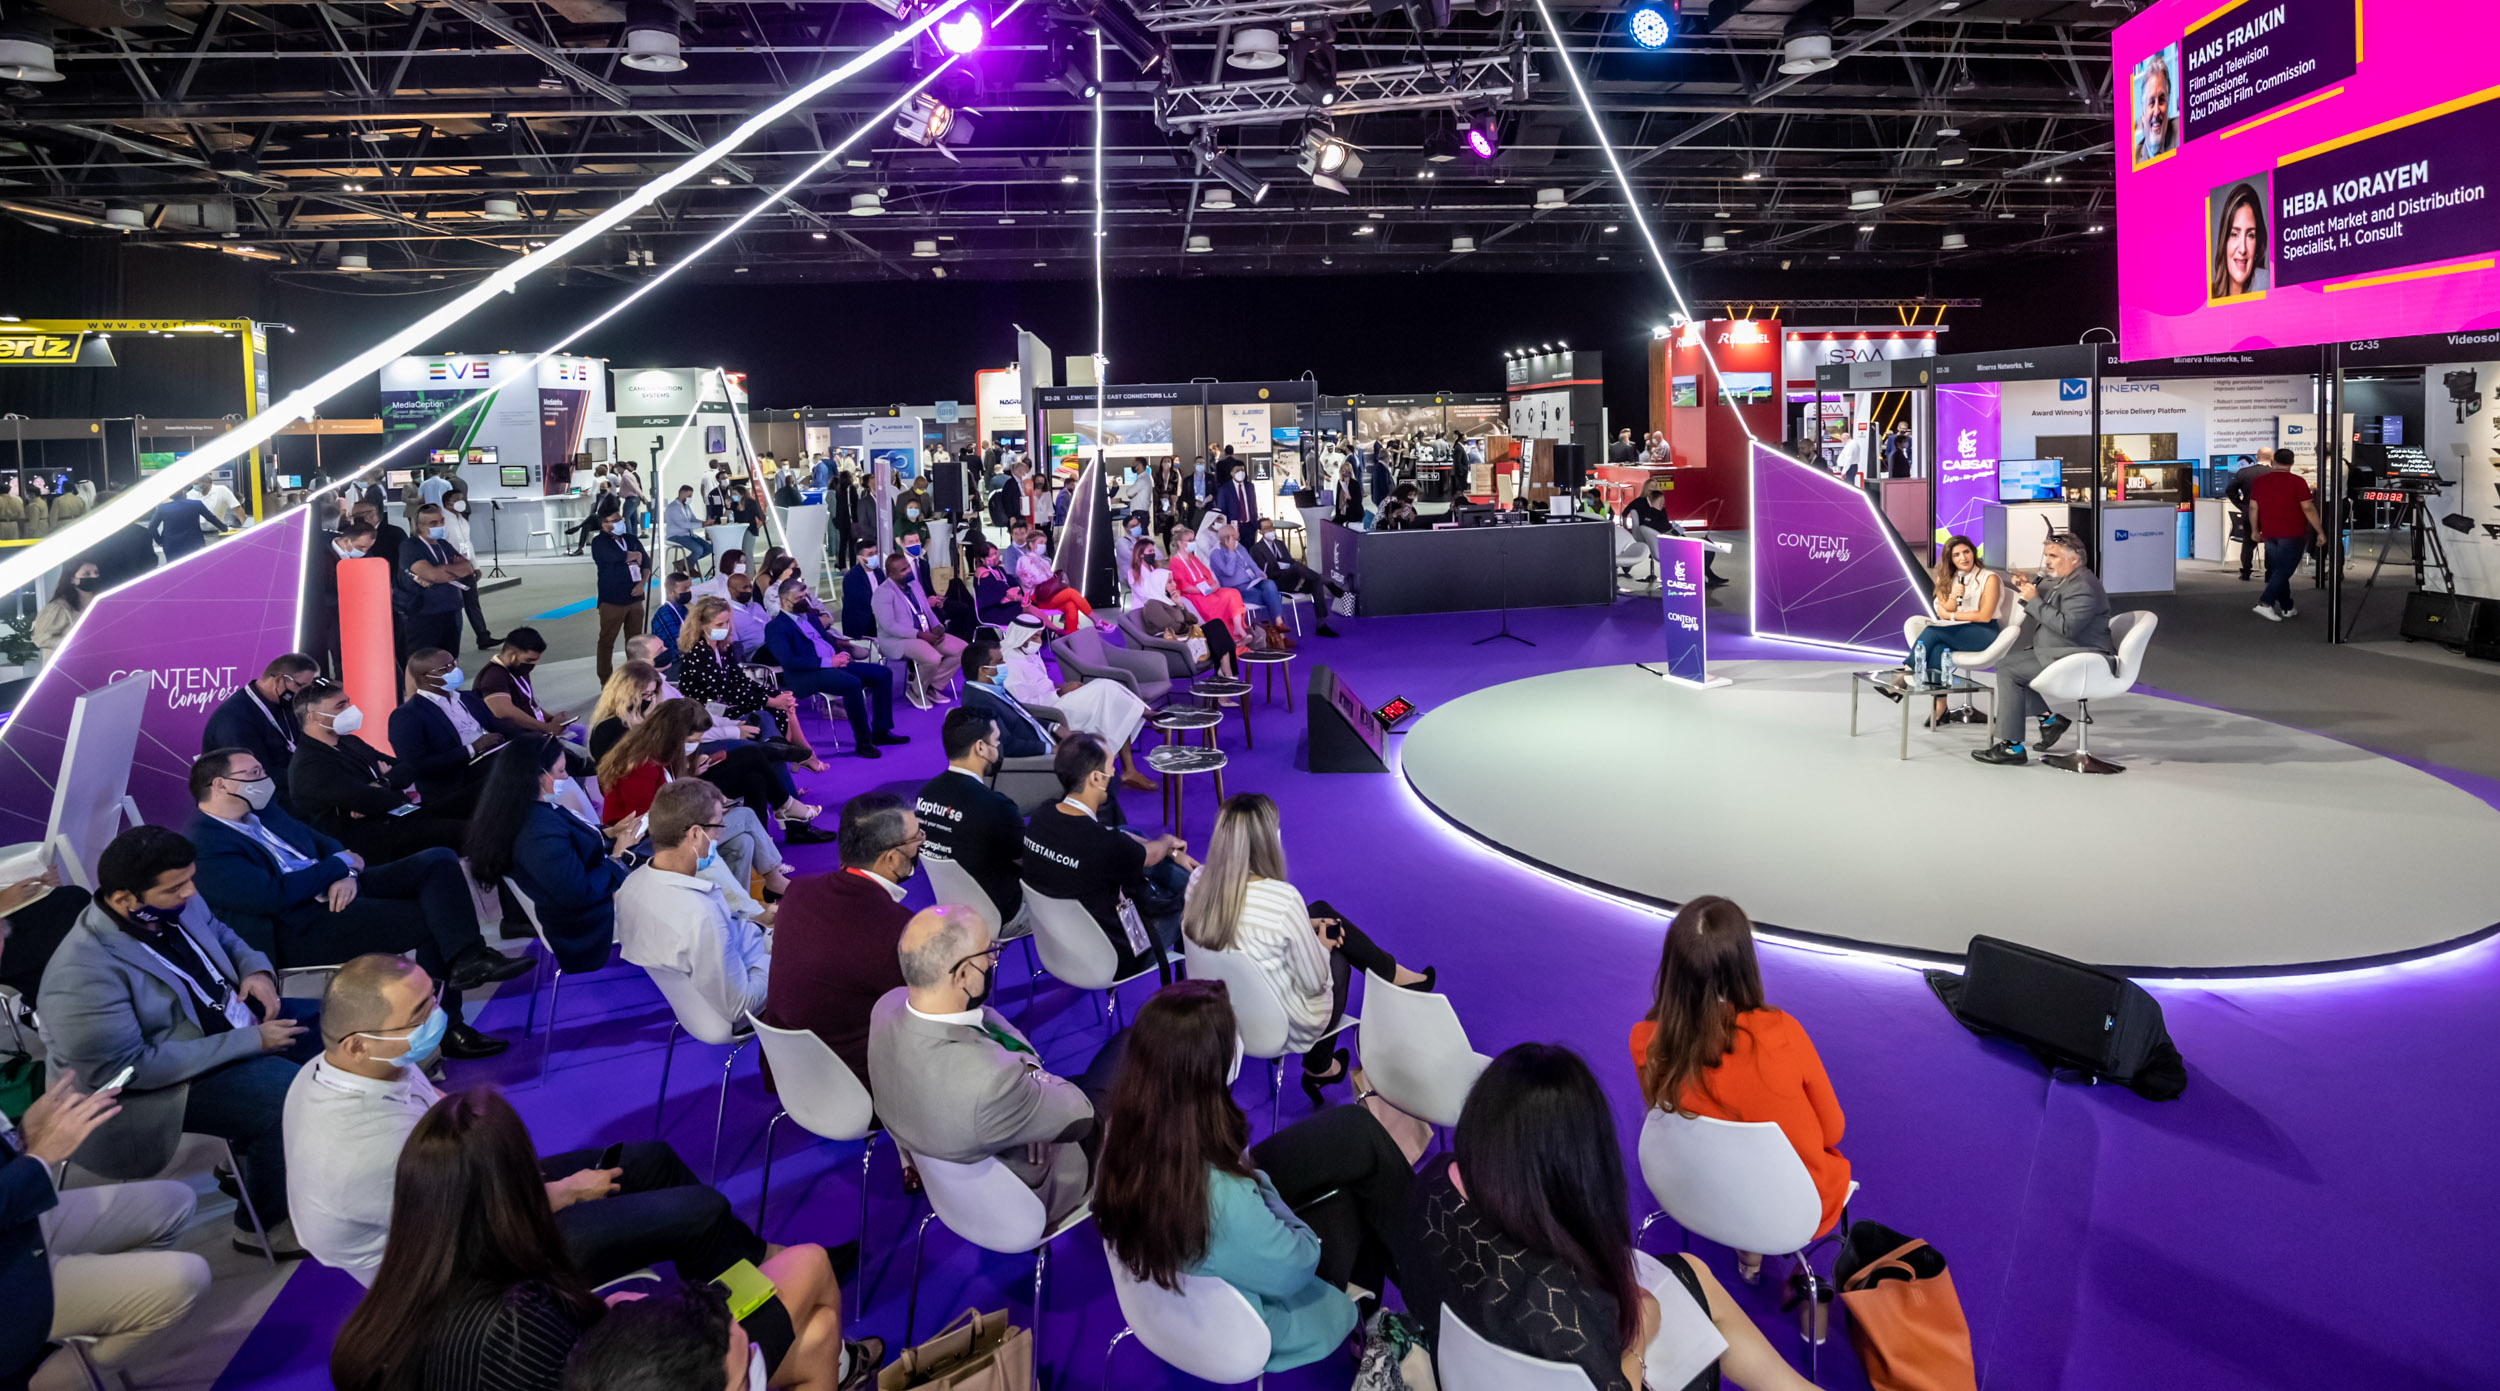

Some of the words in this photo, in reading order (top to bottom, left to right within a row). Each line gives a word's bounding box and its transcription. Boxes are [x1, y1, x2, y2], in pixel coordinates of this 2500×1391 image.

[2189, 37, 2223, 71] HANS
[2226, 3, 2285, 52] FRAIKIN
[2189, 76, 2206, 92] Film
[2208, 64, 2223, 83] and
[2225, 45, 2269, 74] Television
[2189, 72, 2249, 107] Commissioner,
[2190, 107, 2206, 123] Abu
[2208, 93, 2232, 115] Dhabi
[2234, 86, 2253, 103] Film
[2255, 58, 2316, 93] Commission
[2283, 188, 2328, 218] HEBA
[2333, 160, 2428, 206] KORAYEM
[2283, 221, 2325, 242] Content
[2328, 210, 2367, 233] Market
[2371, 203, 2395, 222] and
[2399, 185, 2485, 217] Distribution
[2283, 238, 2337, 261] Specialist,
[2340, 233, 2352, 248] H.
[2355, 221, 2403, 245] Consult
[2350, 340, 2380, 351] C2-35
[1998, 362, 2024, 371] Networks,
[2174, 356, 2202, 364] Minerva
[2204, 355, 2239, 364] Networks,
[2241, 354, 2254, 363] Inc.
[429, 362, 490, 380] EVS
[1123, 392, 1162, 400] CONNECTORS
[392, 401, 445, 409] MediaCeption
[2055, 409, 2083, 417] Winning
[2130, 408, 2156, 416] Delivery
[1942, 459, 1995, 470] CABSAT
[2126, 476, 2146, 489] JOKER
[1777, 533, 1848, 549] CONTENT
[1808, 545, 1851, 564] Congress
[1667, 579, 1696, 591] CABSAT
[1667, 612, 1698, 625] CONTENT
[915, 796, 963, 822] Kapturise
